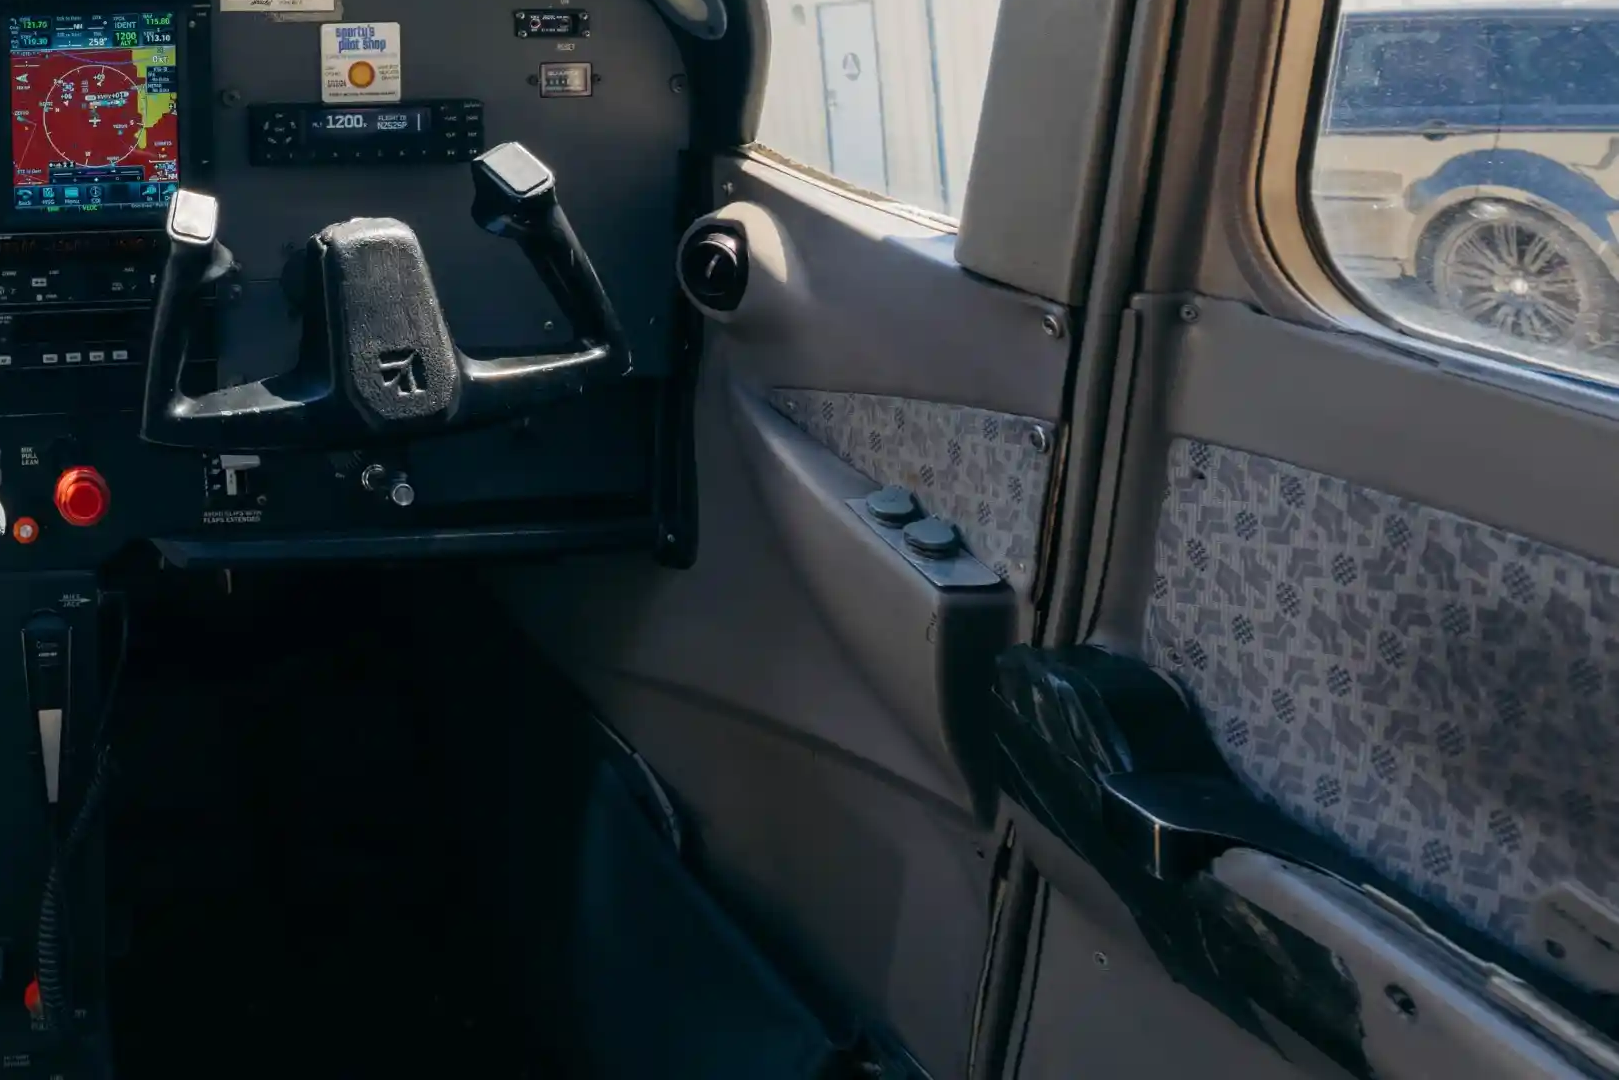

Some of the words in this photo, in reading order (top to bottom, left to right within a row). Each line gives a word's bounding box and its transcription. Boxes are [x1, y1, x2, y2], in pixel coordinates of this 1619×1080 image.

[23, 21, 48, 29] 121.70
[115, 32, 137, 40] 1200
[336, 24, 375, 40] sporty's
[89, 38, 108, 47] 258°
[146, 34, 171, 42] 113.10
[339, 39, 360, 53] pilot
[363, 38, 386, 52] shop
[326, 114, 363, 129] 1200
